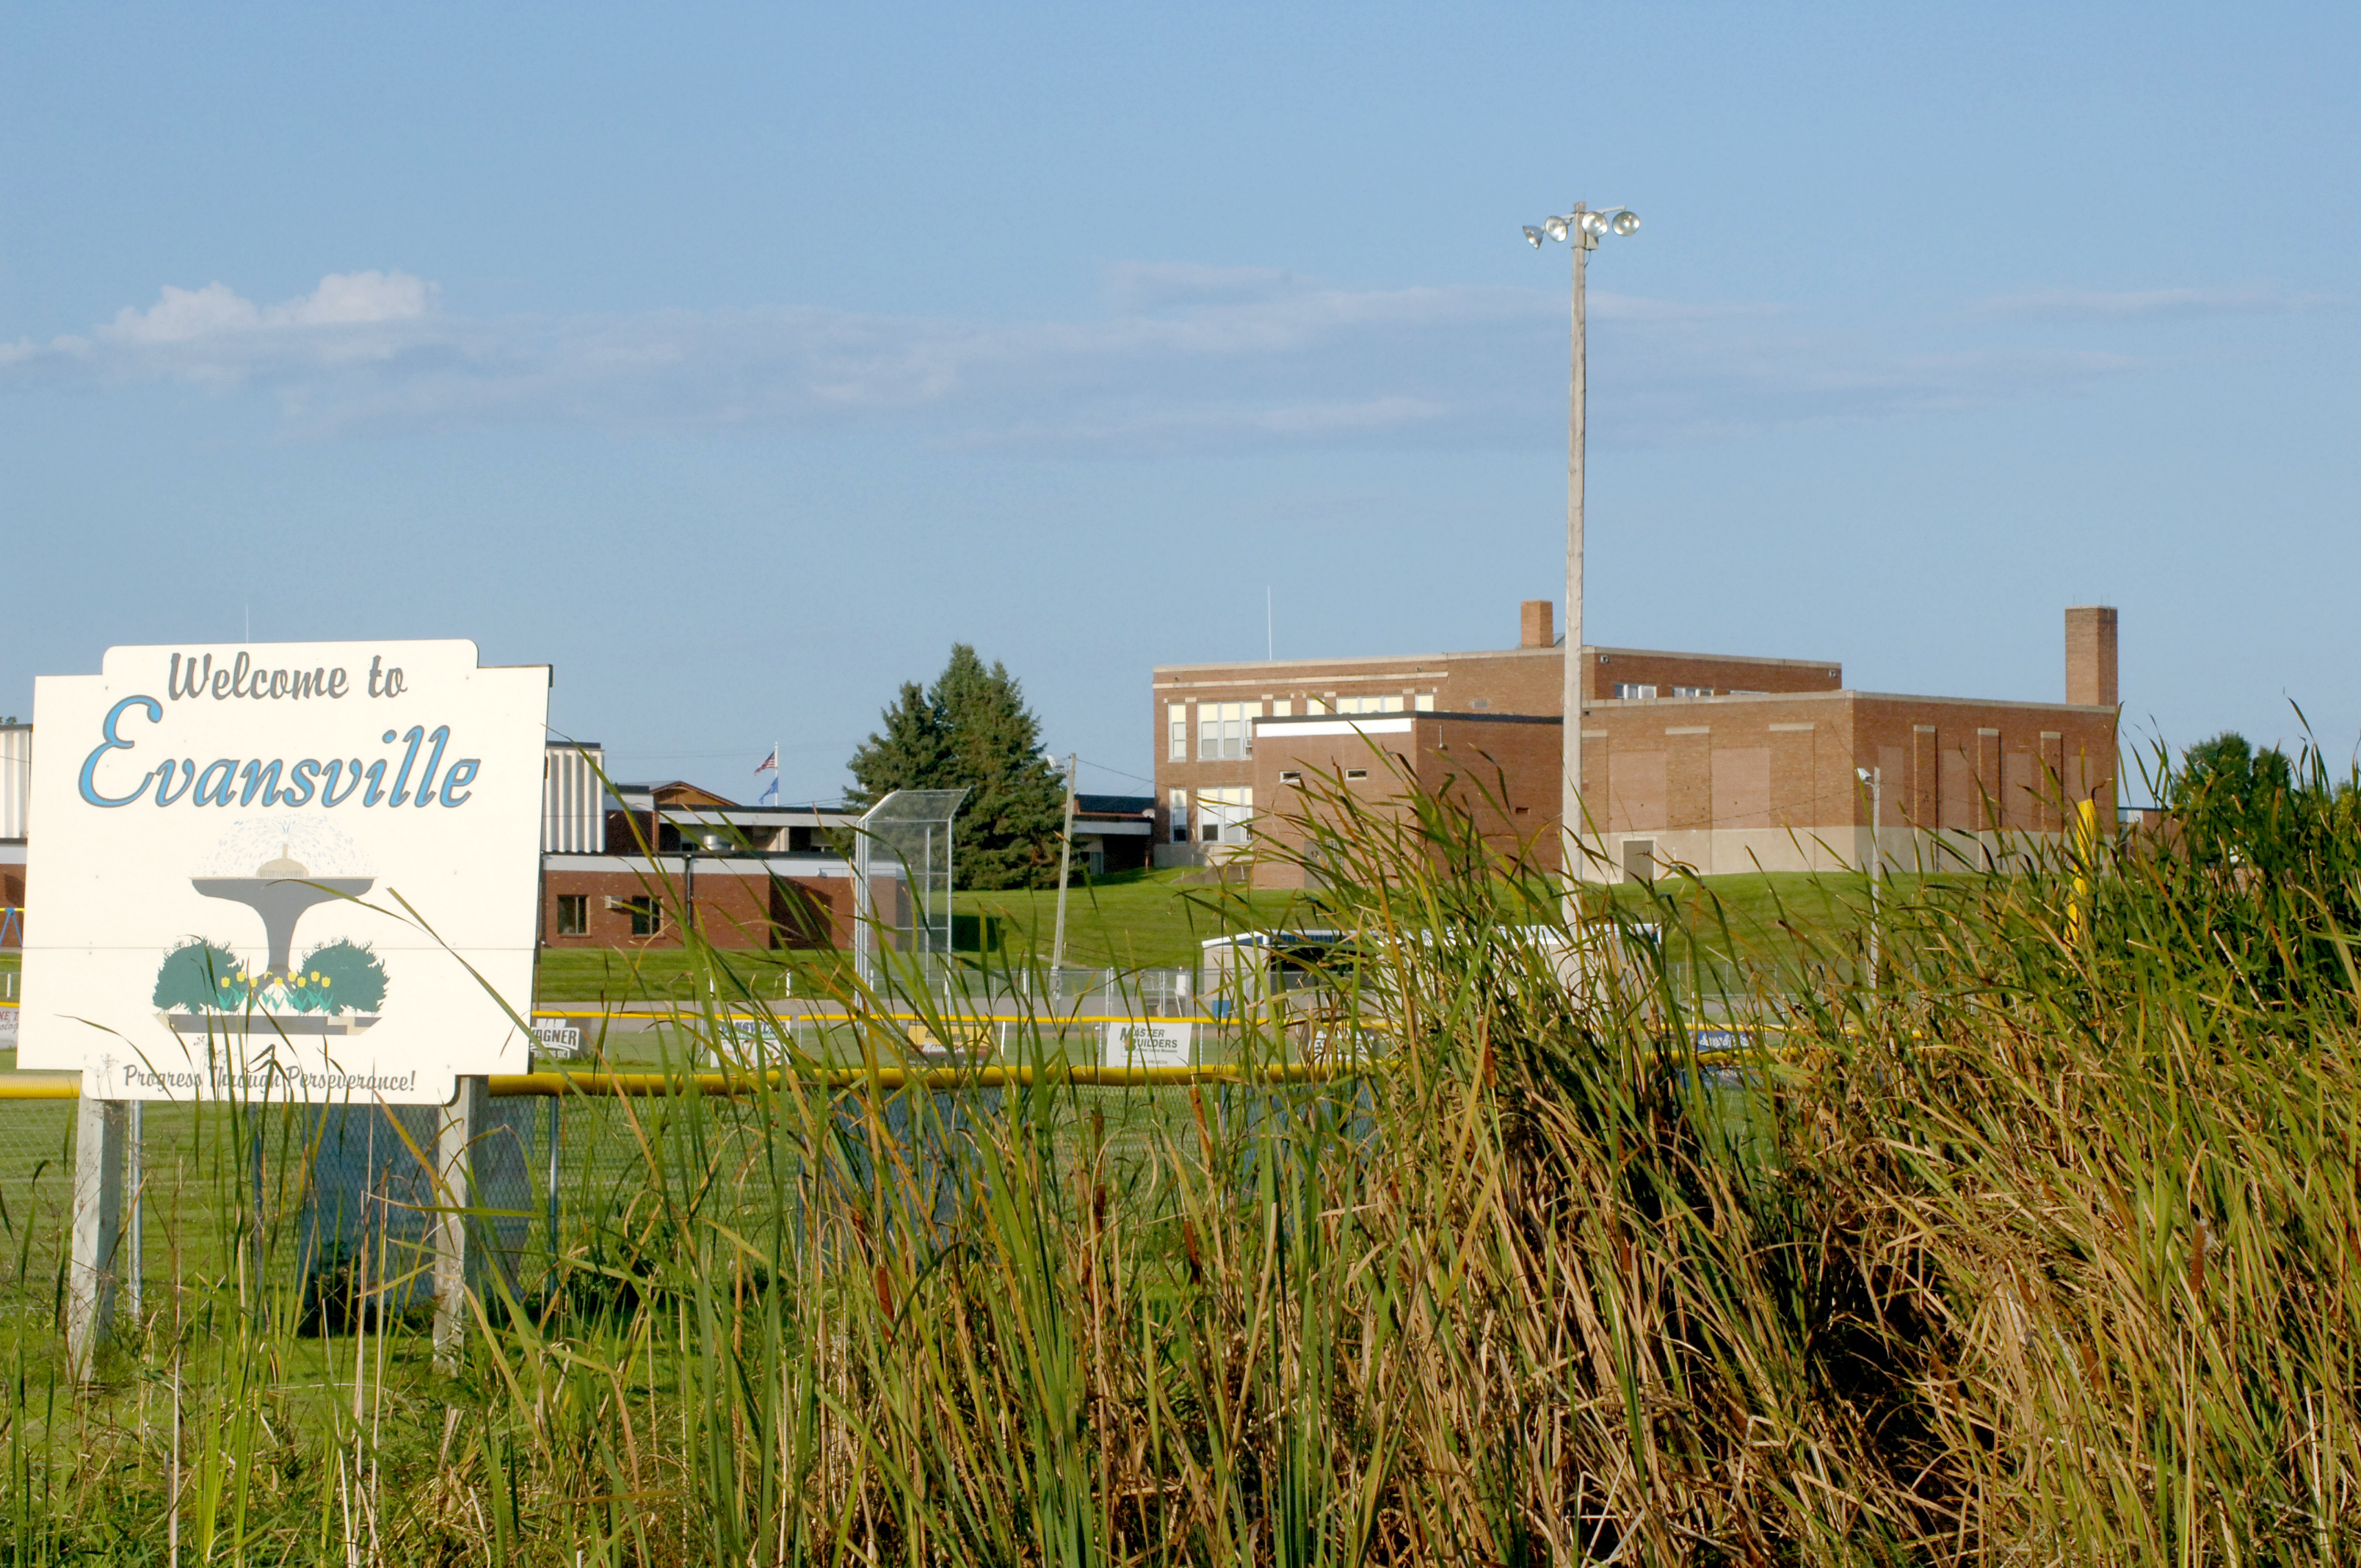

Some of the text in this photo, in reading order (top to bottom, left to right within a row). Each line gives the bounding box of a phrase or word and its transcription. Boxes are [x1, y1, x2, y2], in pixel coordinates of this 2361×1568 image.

[168, 651, 408, 701] Welcome to
[79, 695, 482, 808] Evansville
[532, 1029, 577, 1047] AGNER
[123, 1064, 202, 1092] Progress
[286, 1065, 416, 1092] Perseverance!
